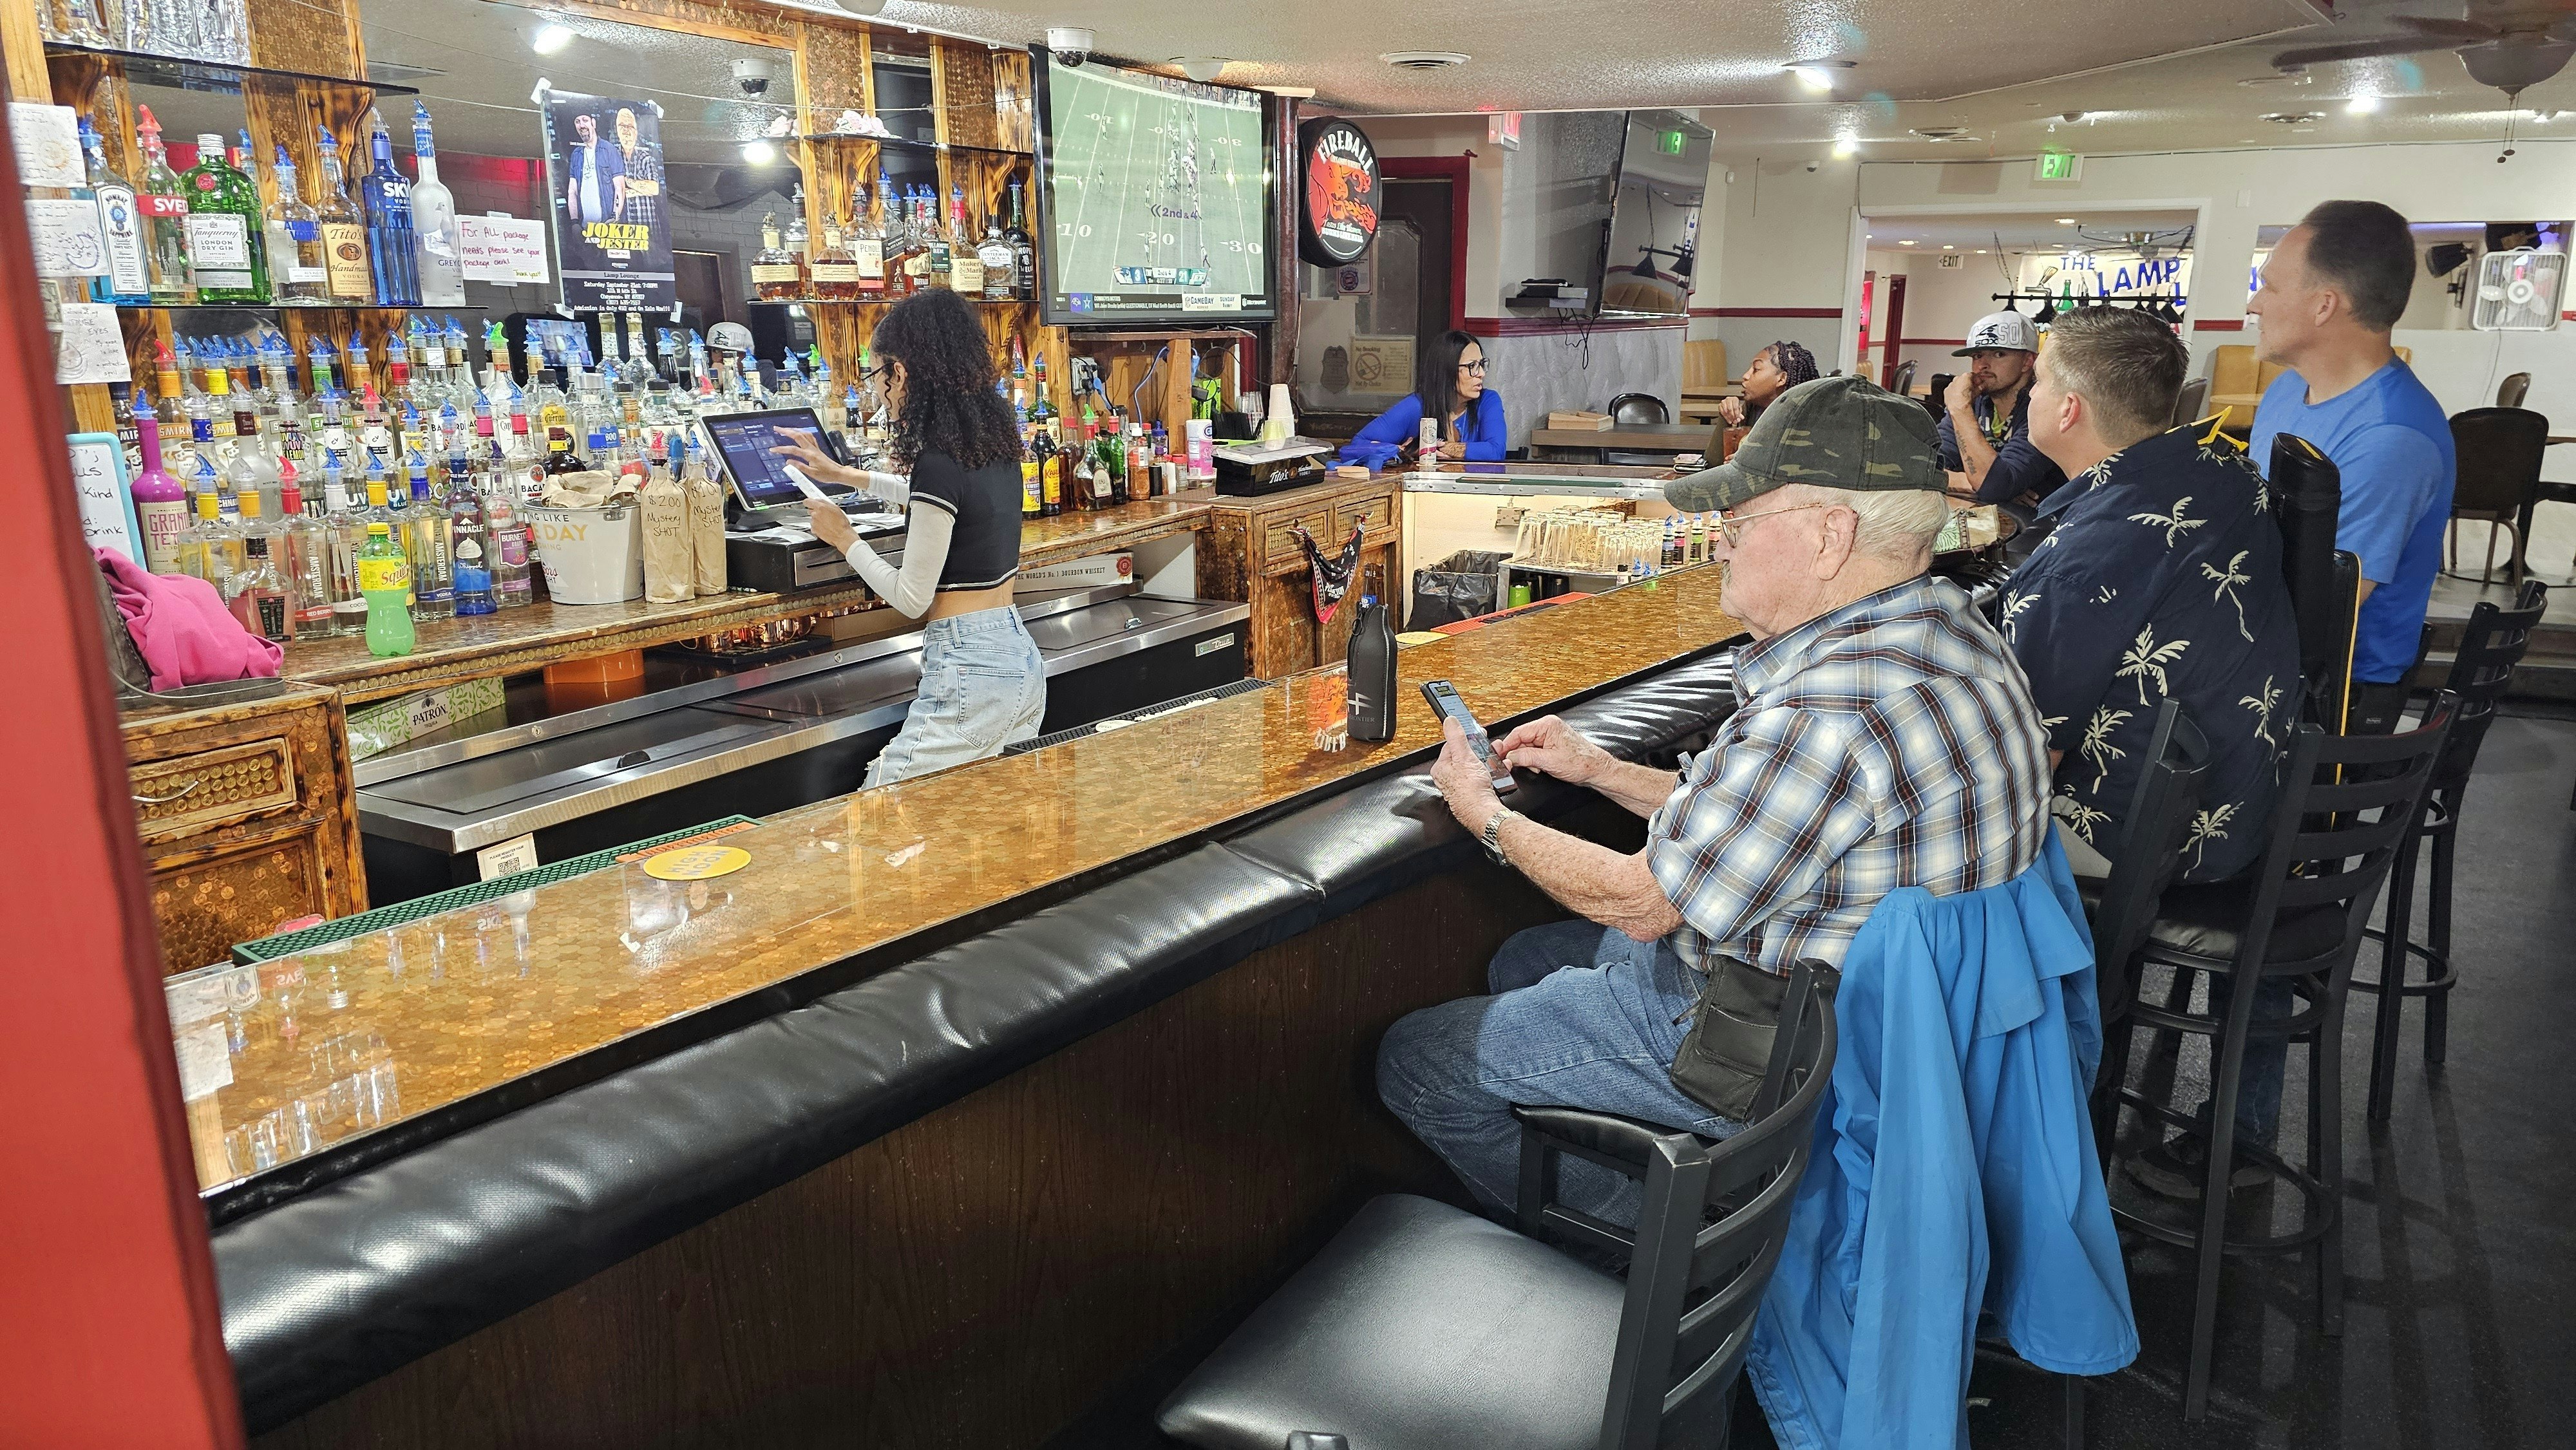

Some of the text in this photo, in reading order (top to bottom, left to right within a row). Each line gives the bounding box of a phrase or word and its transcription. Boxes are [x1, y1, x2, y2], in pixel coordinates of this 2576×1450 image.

[1317, 130, 1374, 176] FIREBALL
[2042, 154, 2076, 178] EXIT
[1162, 207, 1183, 218] 2nd
[194, 227, 239, 239] Tanqueray
[330, 227, 363, 240] Tito's
[461, 221, 529, 241] For ALL package
[582, 221, 649, 240] JOKER
[462, 246, 484, 255] needs
[488, 245, 509, 257] please
[527, 249, 540, 258] your
[596, 238, 649, 251] JESTER
[464, 259, 489, 268] package
[1942, 255, 1960, 268] EXIT
[2060, 256, 2096, 270] THE
[1179, 270, 1188, 283] 21
[2097, 256, 2180, 297] LAMP
[1975, 338, 1998, 347] SOX
[1269, 469, 1289, 484] Tito's
[82, 486, 113, 498] Kind
[648, 494, 681, 508] $200
[149, 512, 190, 532] GRAND
[543, 513, 570, 522] LIKE
[647, 513, 681, 528] Mystery
[543, 523, 589, 541] DAY
[653, 527, 680, 538] SHOT
[435, 541, 448, 582] AMSTERDAM
[457, 561, 483, 570] Whipped
[308, 556, 324, 599] AMSTERDAM
[1084, 567, 1106, 576] WHISKEY
[412, 702, 448, 726] PATRÓN
[501, 848, 516, 856] REGISTER
[663, 851, 710, 873] HIGH
[681, 849, 733, 876] NOON
